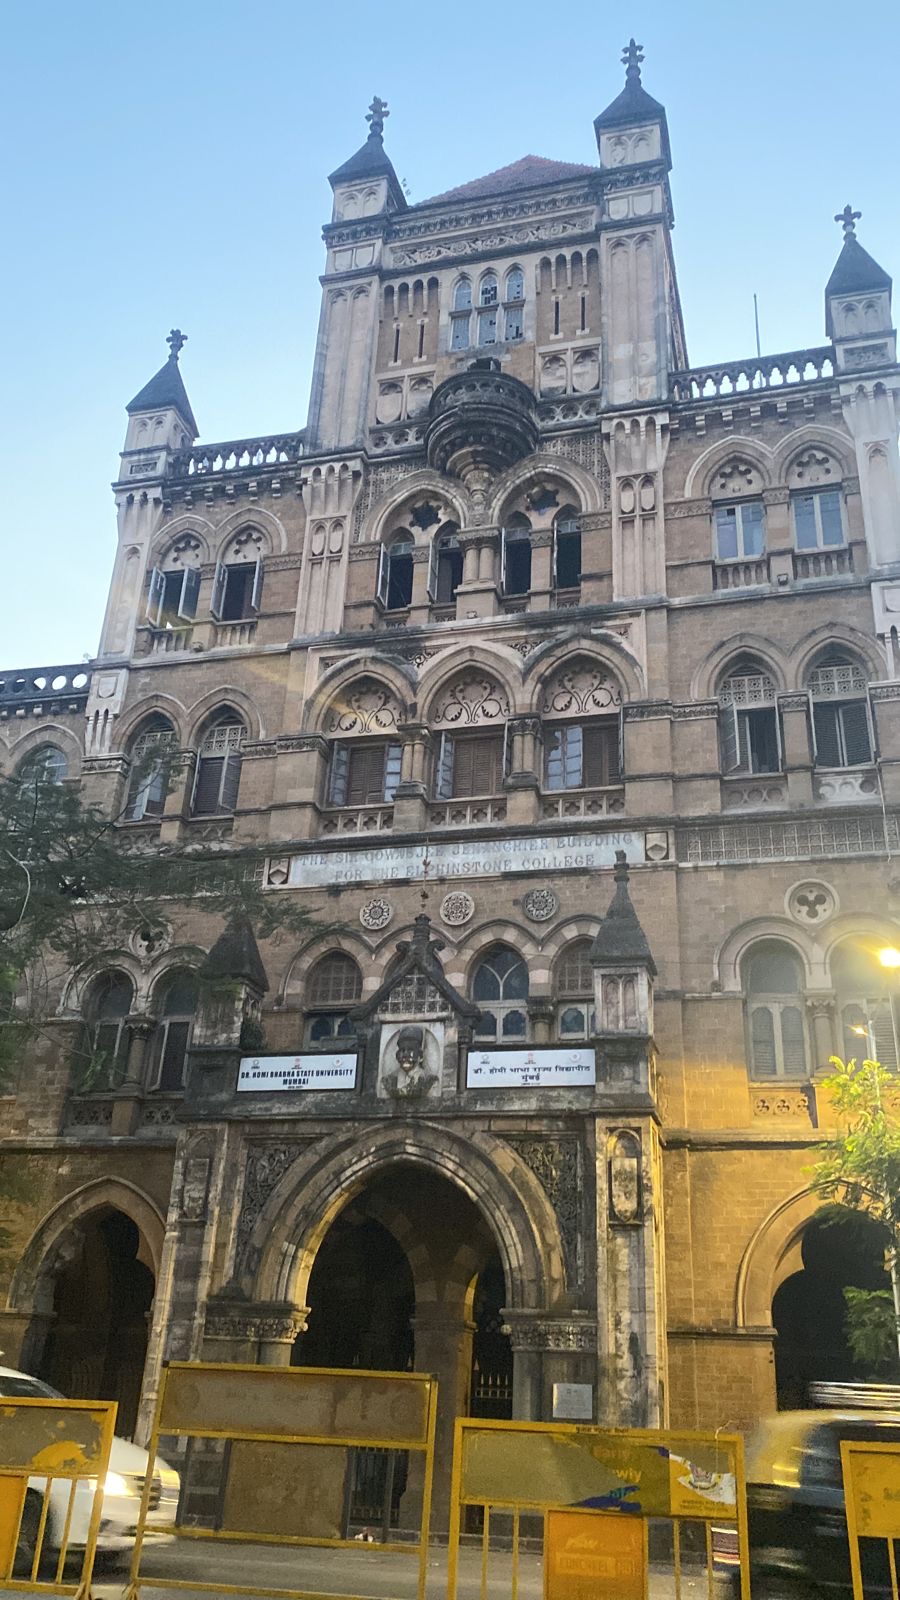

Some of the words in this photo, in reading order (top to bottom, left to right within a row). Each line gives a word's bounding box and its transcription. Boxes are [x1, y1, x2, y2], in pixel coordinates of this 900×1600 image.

[301, 855, 328, 866] THE
[336, 852, 358, 864] SIR
[557, 833, 633, 848] BUILDING
[335, 869, 362, 881] FOR
[373, 866, 399, 879] THE
[406, 859, 512, 877] ELPHINSTONE
[522, 854, 595, 870] COLLEGE
[252, 1071, 269, 1079] HOMI
[270, 1070, 295, 1078] BHABHA
[296, 1070, 315, 1078] STATE
[315, 1069, 353, 1077] UNIVERSITY
